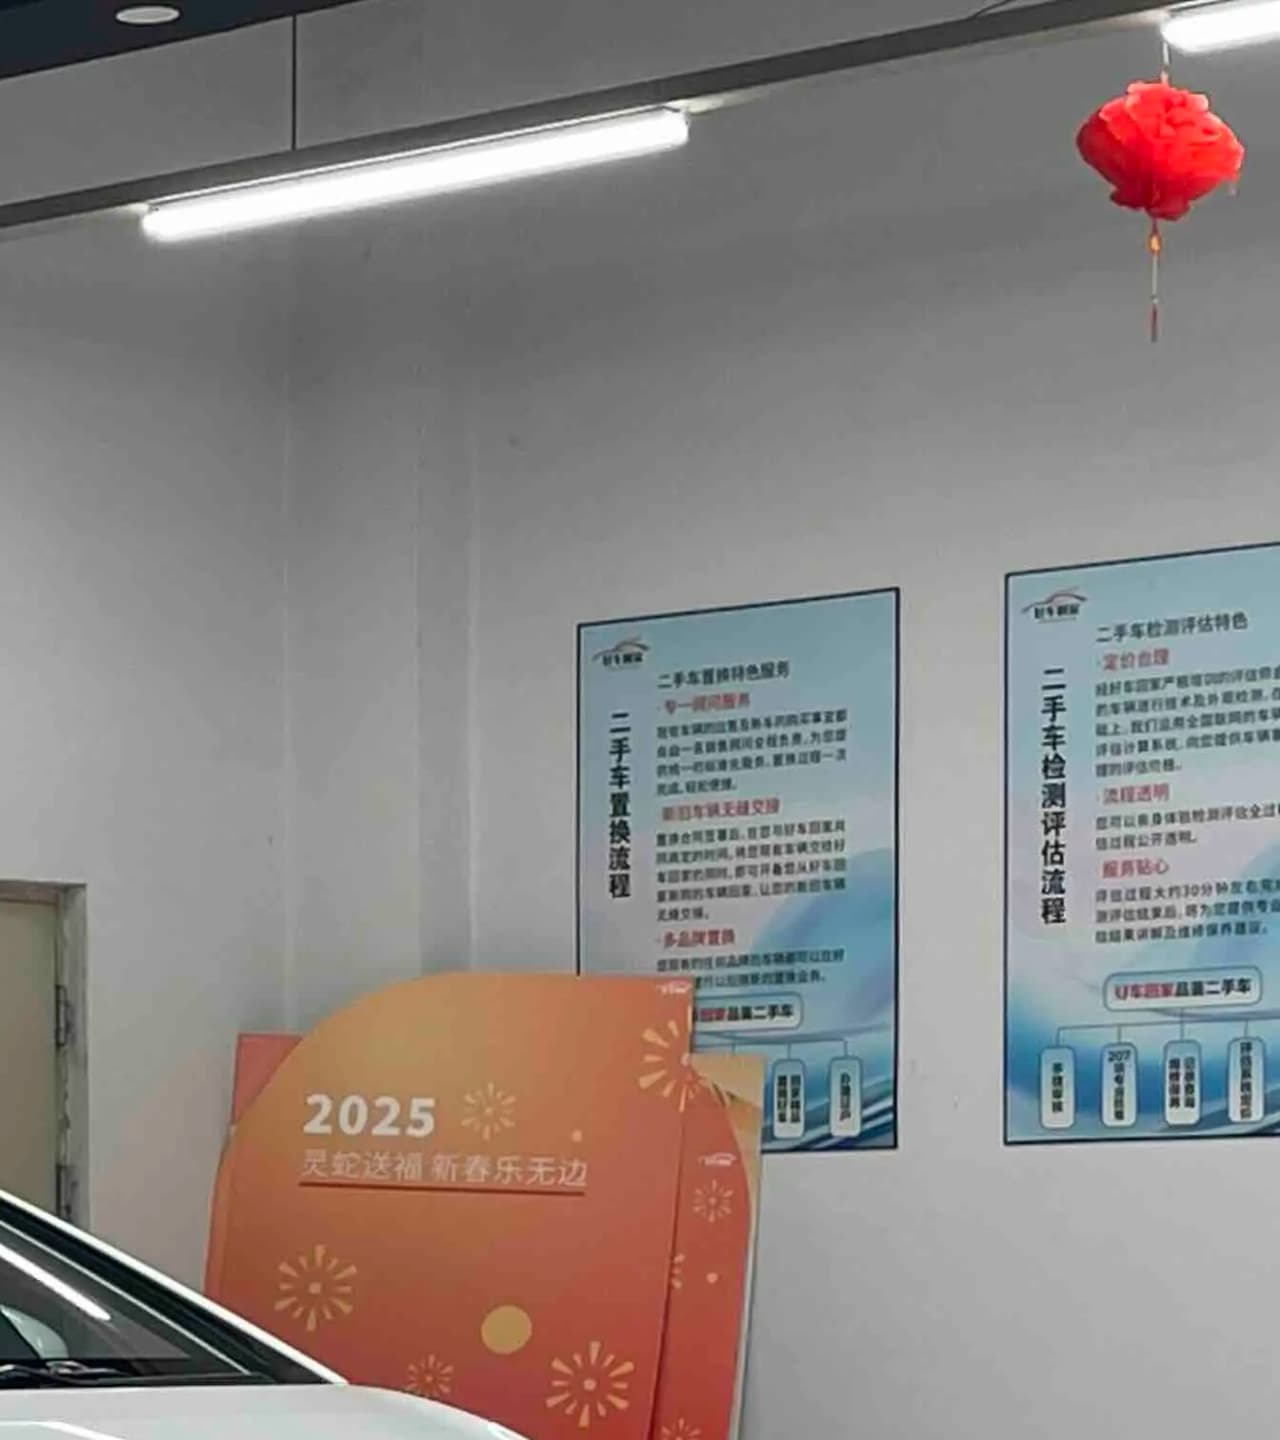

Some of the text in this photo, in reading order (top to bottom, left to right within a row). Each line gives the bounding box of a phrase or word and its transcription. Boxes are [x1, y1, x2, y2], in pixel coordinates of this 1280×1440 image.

[609, 712, 631, 899] 二手车置换流程
[1041, 668, 1066, 925] 二手车检测评估流程
[302, 1149, 589, 1188] 灵蛇送福 新春乐无边
[303, 1094, 437, 1138] 2025
